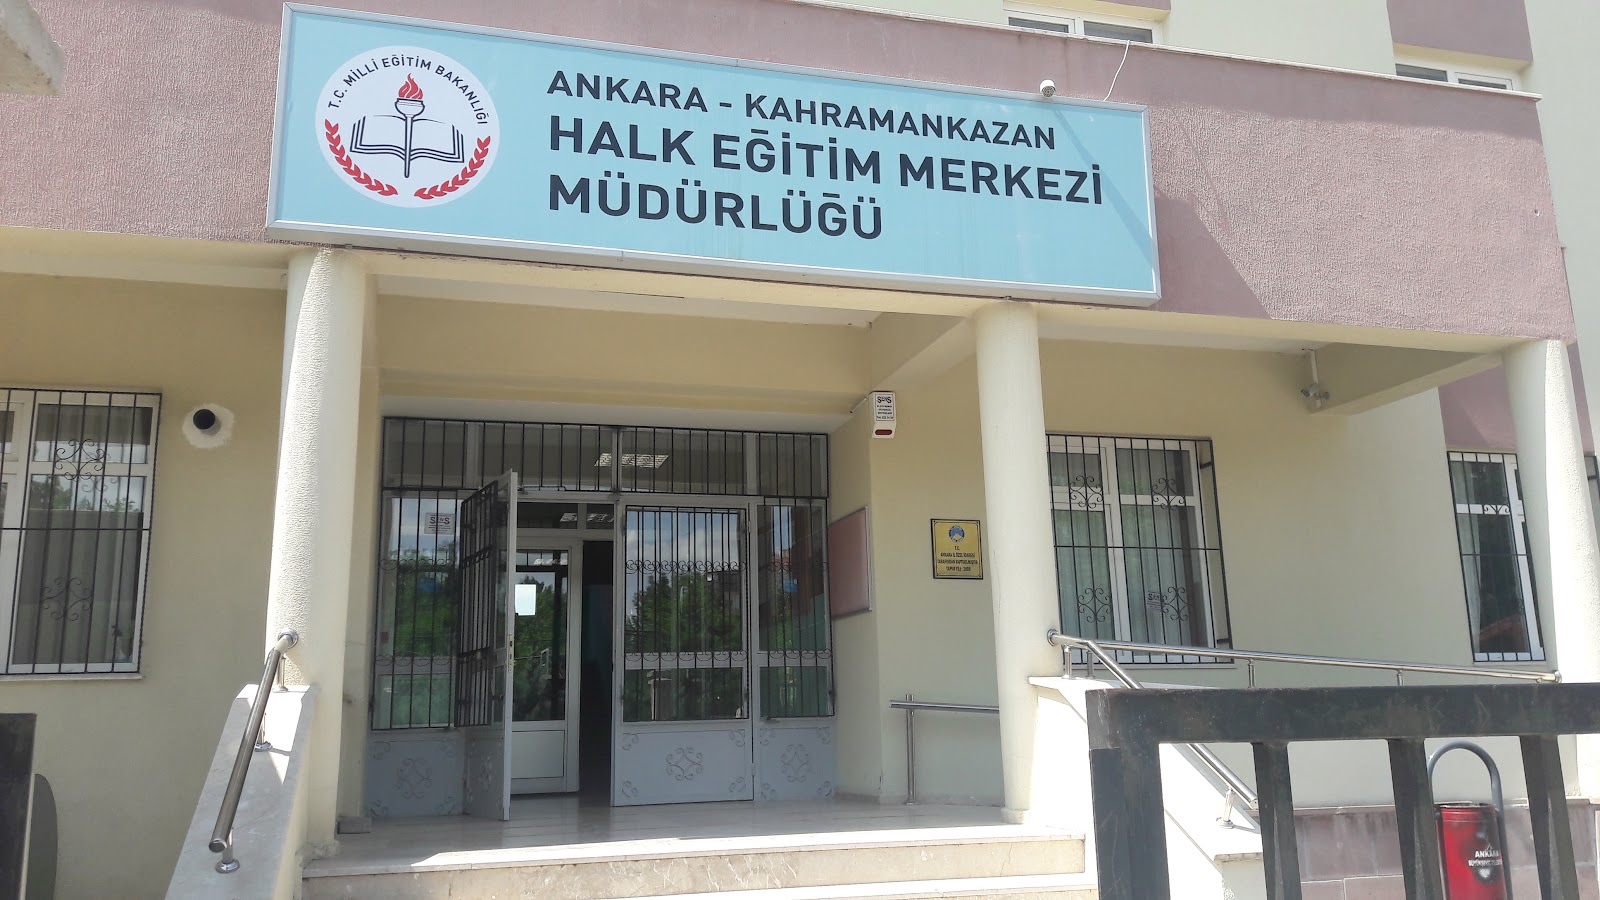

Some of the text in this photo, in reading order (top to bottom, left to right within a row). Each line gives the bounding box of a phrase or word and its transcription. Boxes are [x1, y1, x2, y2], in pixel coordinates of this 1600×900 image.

[328, 89, 348, 109] T.C.
[381, 54, 432, 71] EĞİTİM
[435, 65, 488, 125] BAKANLIĞI
[546, 70, 708, 113] ANKARA
[745, 93, 1055, 150] KAHRAMANKAZAN
[550, 115, 1102, 205] HALK EĞİTİM MERKEZİ
[549, 170, 882, 239] MÜDÜRLÜĞÜ
